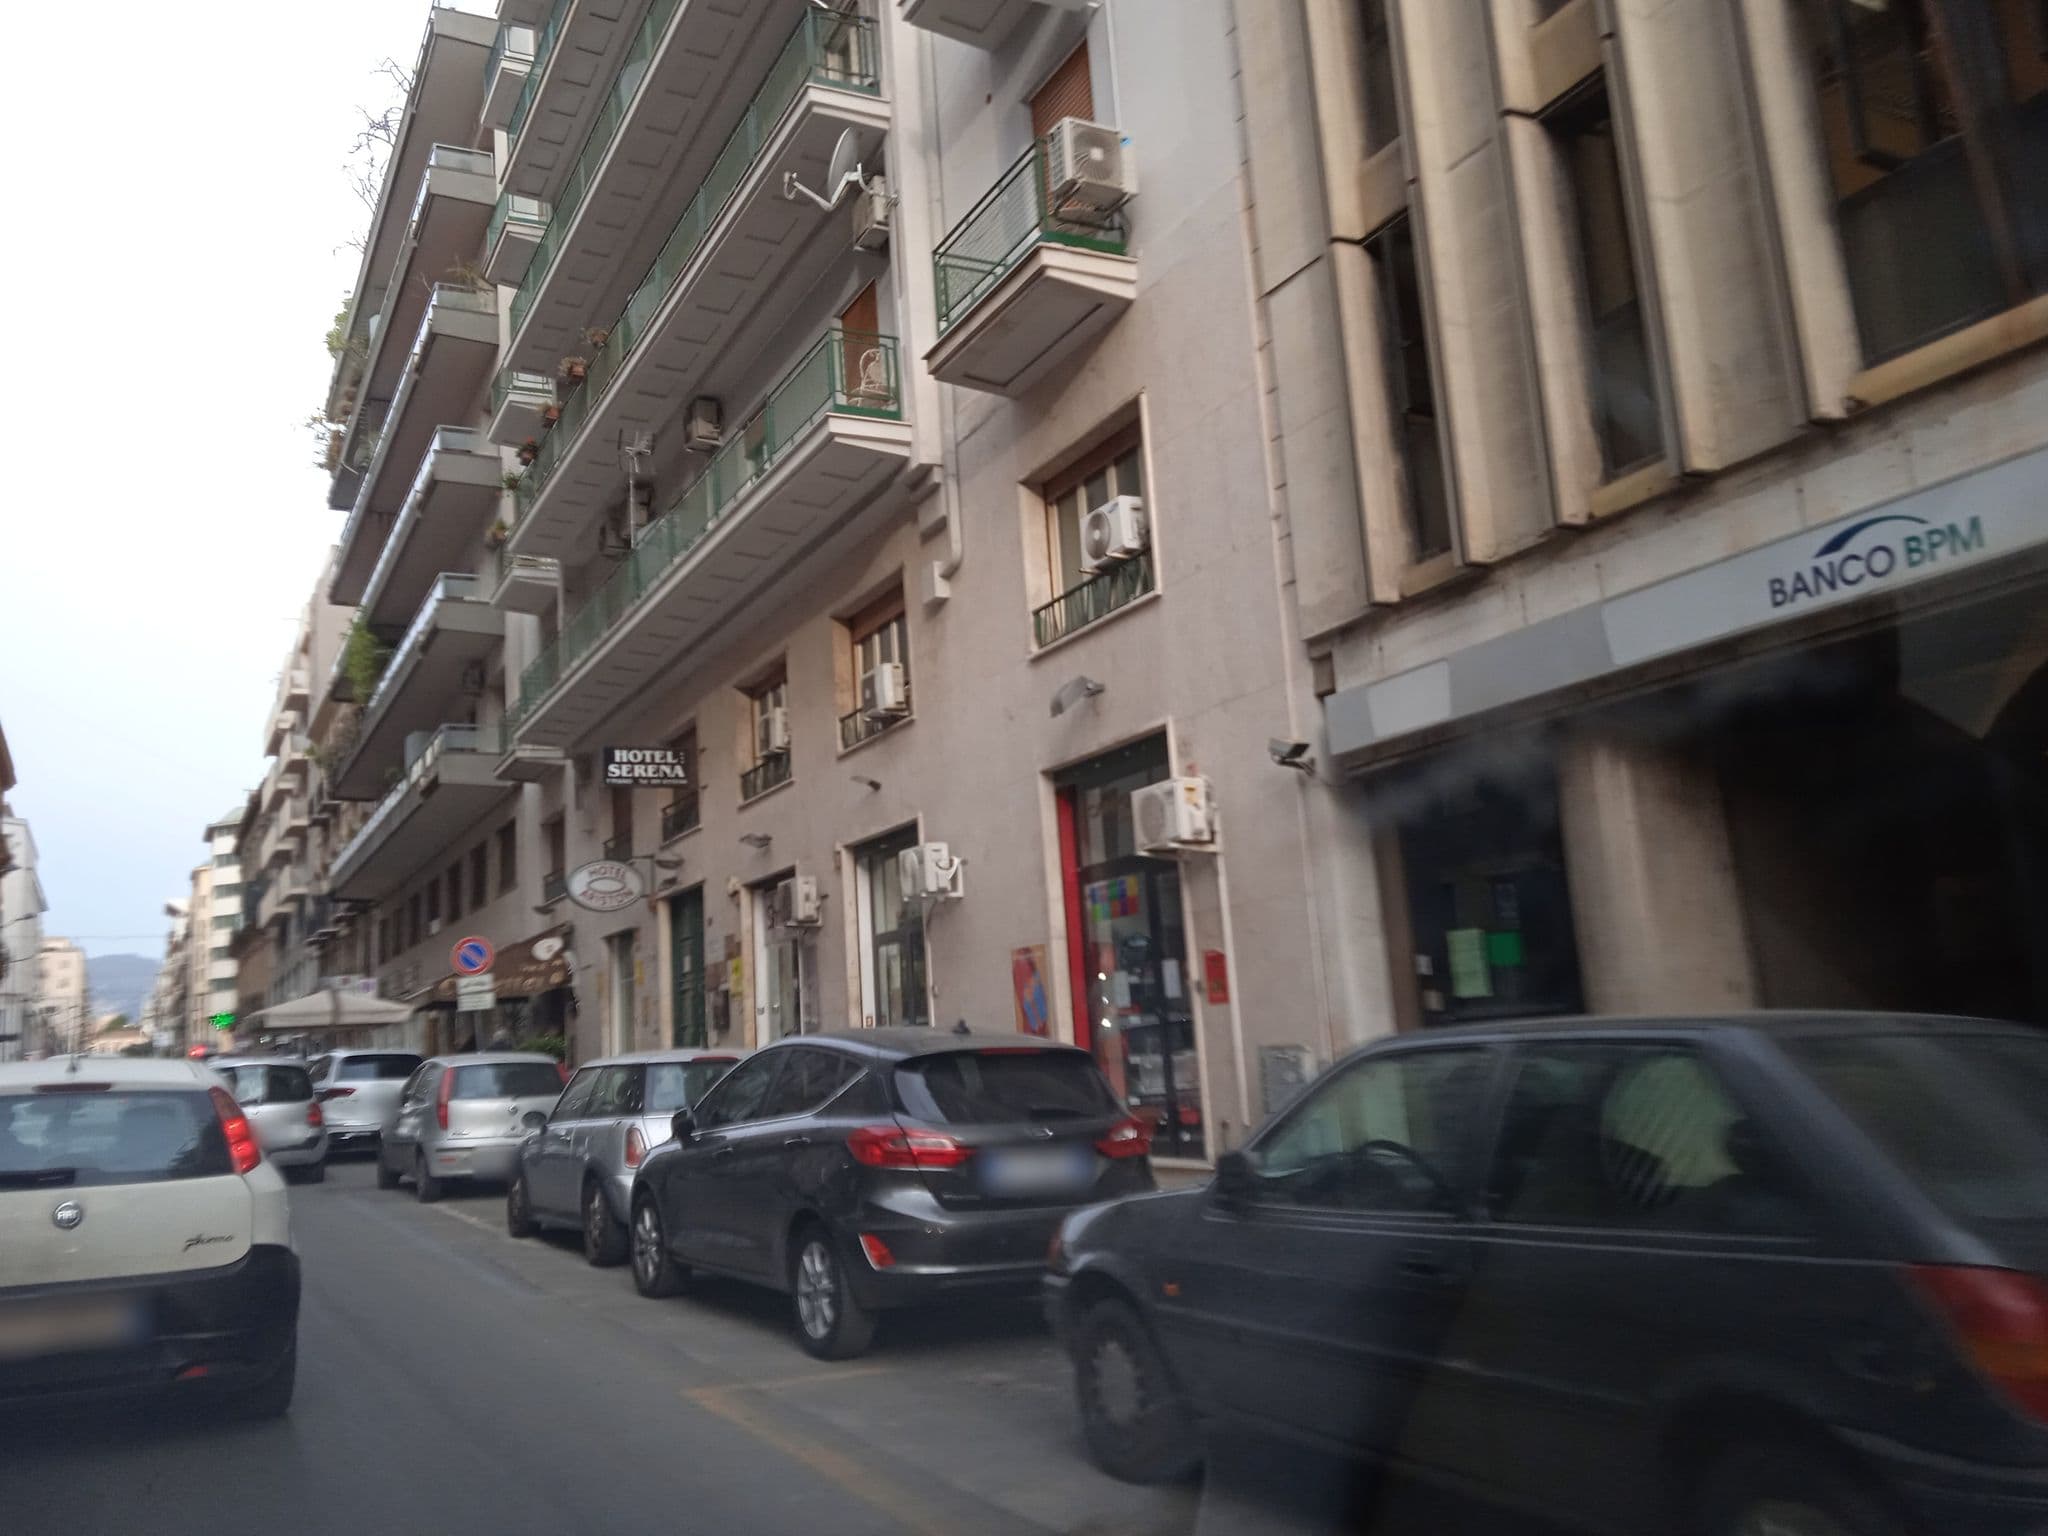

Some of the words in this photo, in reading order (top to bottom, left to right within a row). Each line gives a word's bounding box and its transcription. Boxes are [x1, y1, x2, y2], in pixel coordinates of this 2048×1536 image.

[1767, 545, 1896, 608] BANCO
[1903, 515, 1986, 569] BPM
[614, 749, 678, 763] HOTEL
[607, 763, 685, 778] SERENA
